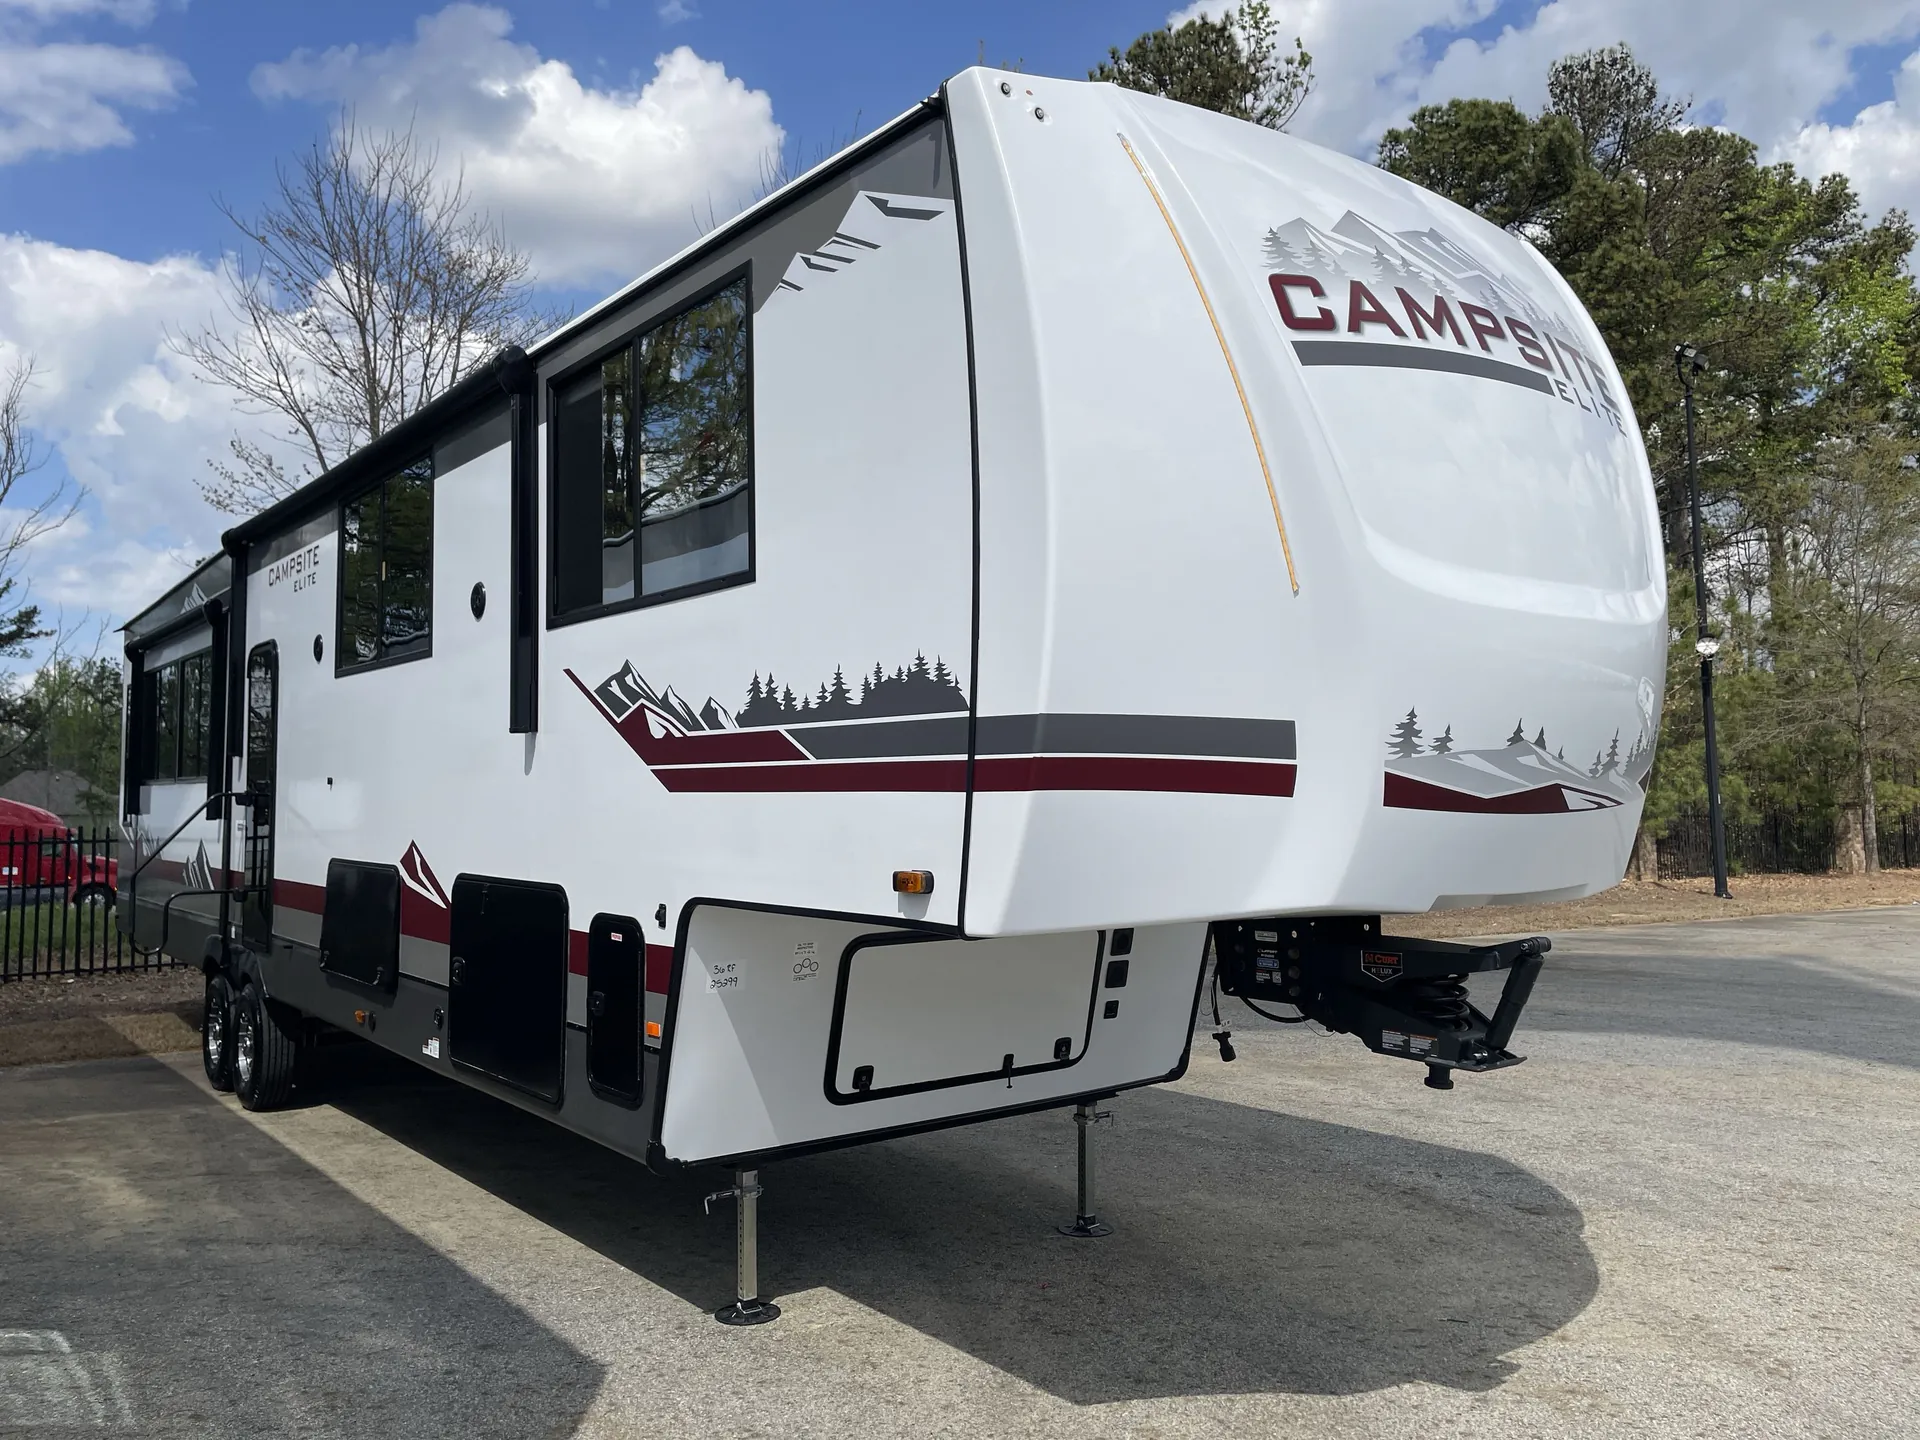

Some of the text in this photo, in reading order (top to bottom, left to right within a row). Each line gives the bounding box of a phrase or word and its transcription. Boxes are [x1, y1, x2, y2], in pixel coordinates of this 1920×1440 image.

[1268, 273, 1622, 416] CAMPSITE
[1553, 378, 1627, 438] ELITE
[268, 545, 320, 587] CAMPSITE
[293, 572, 316, 593] ELITE
[709, 976, 738, 989] 25299
[713, 964, 726, 975] 36
